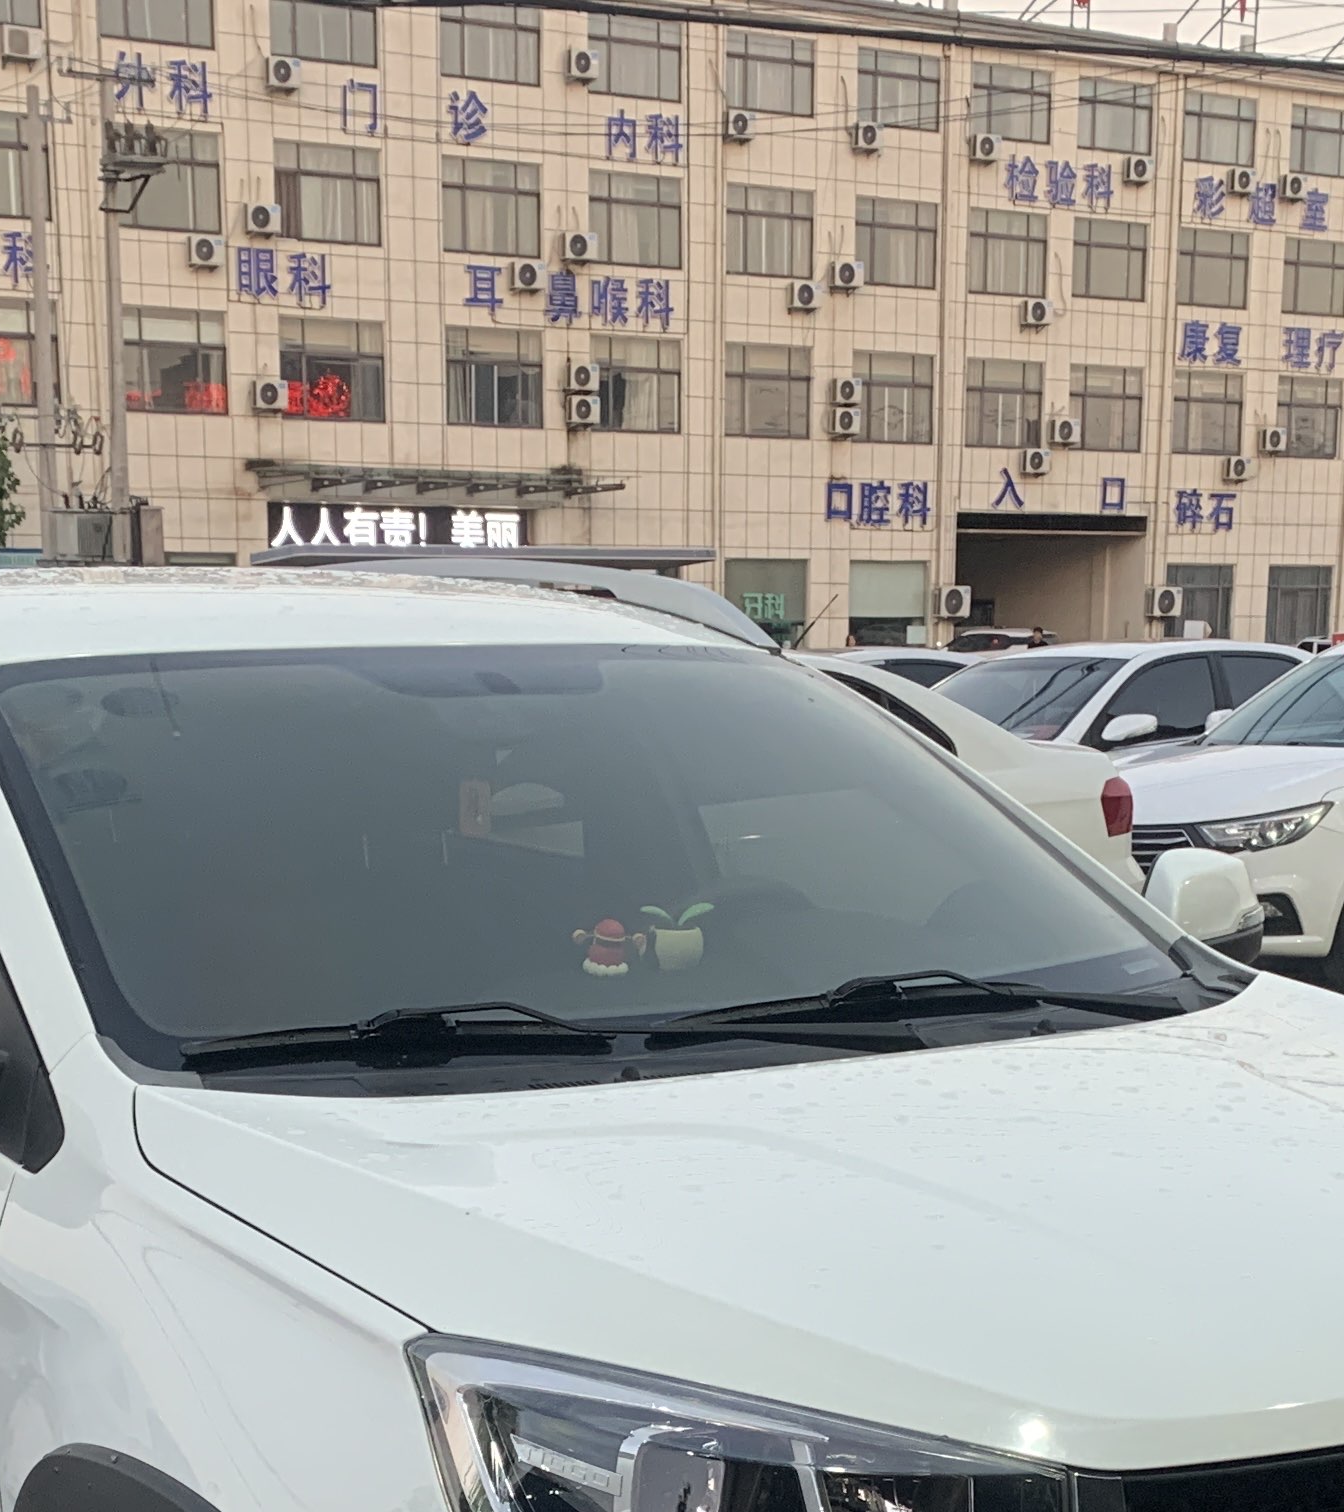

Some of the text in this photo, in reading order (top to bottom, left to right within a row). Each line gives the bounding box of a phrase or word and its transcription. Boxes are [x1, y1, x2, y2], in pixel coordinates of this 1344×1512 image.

[115, 51, 212, 115] 外科
[342, 79, 489, 143] 门诊
[606, 110, 683, 163] 内科
[1005, 154, 1114, 211] 检验科
[1193, 176, 1329, 232] 彩超室
[236, 246, 331, 308] 眼科
[464, 264, 674, 330] 耳鼻喉科
[1178, 320, 1242, 366] 康复
[1282, 327, 1344, 371] 理疗
[825, 479, 930, 526] 口腔科
[994, 468, 1126, 514] 入口
[1174, 489, 1237, 531] 碎石
[451, 510, 521, 547] 美丽
